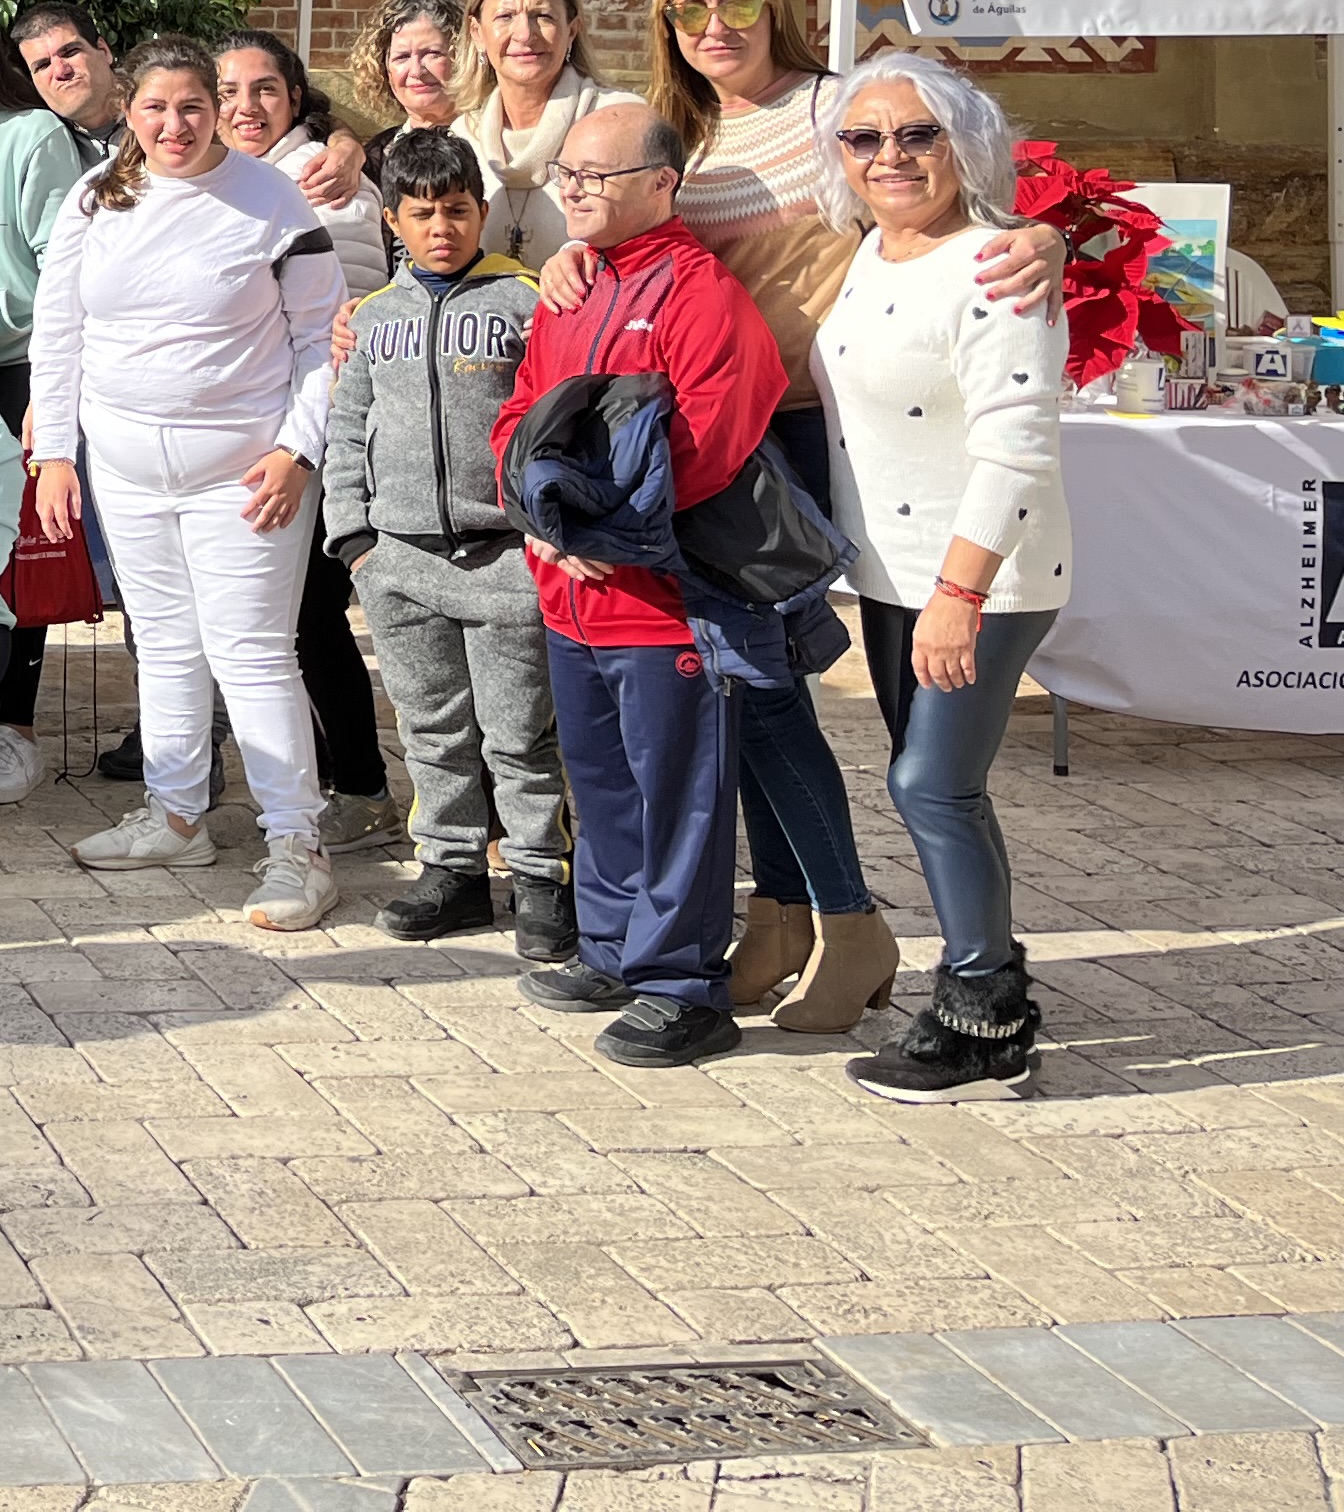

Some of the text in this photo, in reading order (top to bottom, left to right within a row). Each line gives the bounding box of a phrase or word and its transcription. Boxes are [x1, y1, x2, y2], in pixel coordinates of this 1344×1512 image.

[973, 2, 1027, 16] de Águilas
[368, 311, 509, 367] JUNIOR
[1299, 479, 1317, 649] ALZHEIMER
